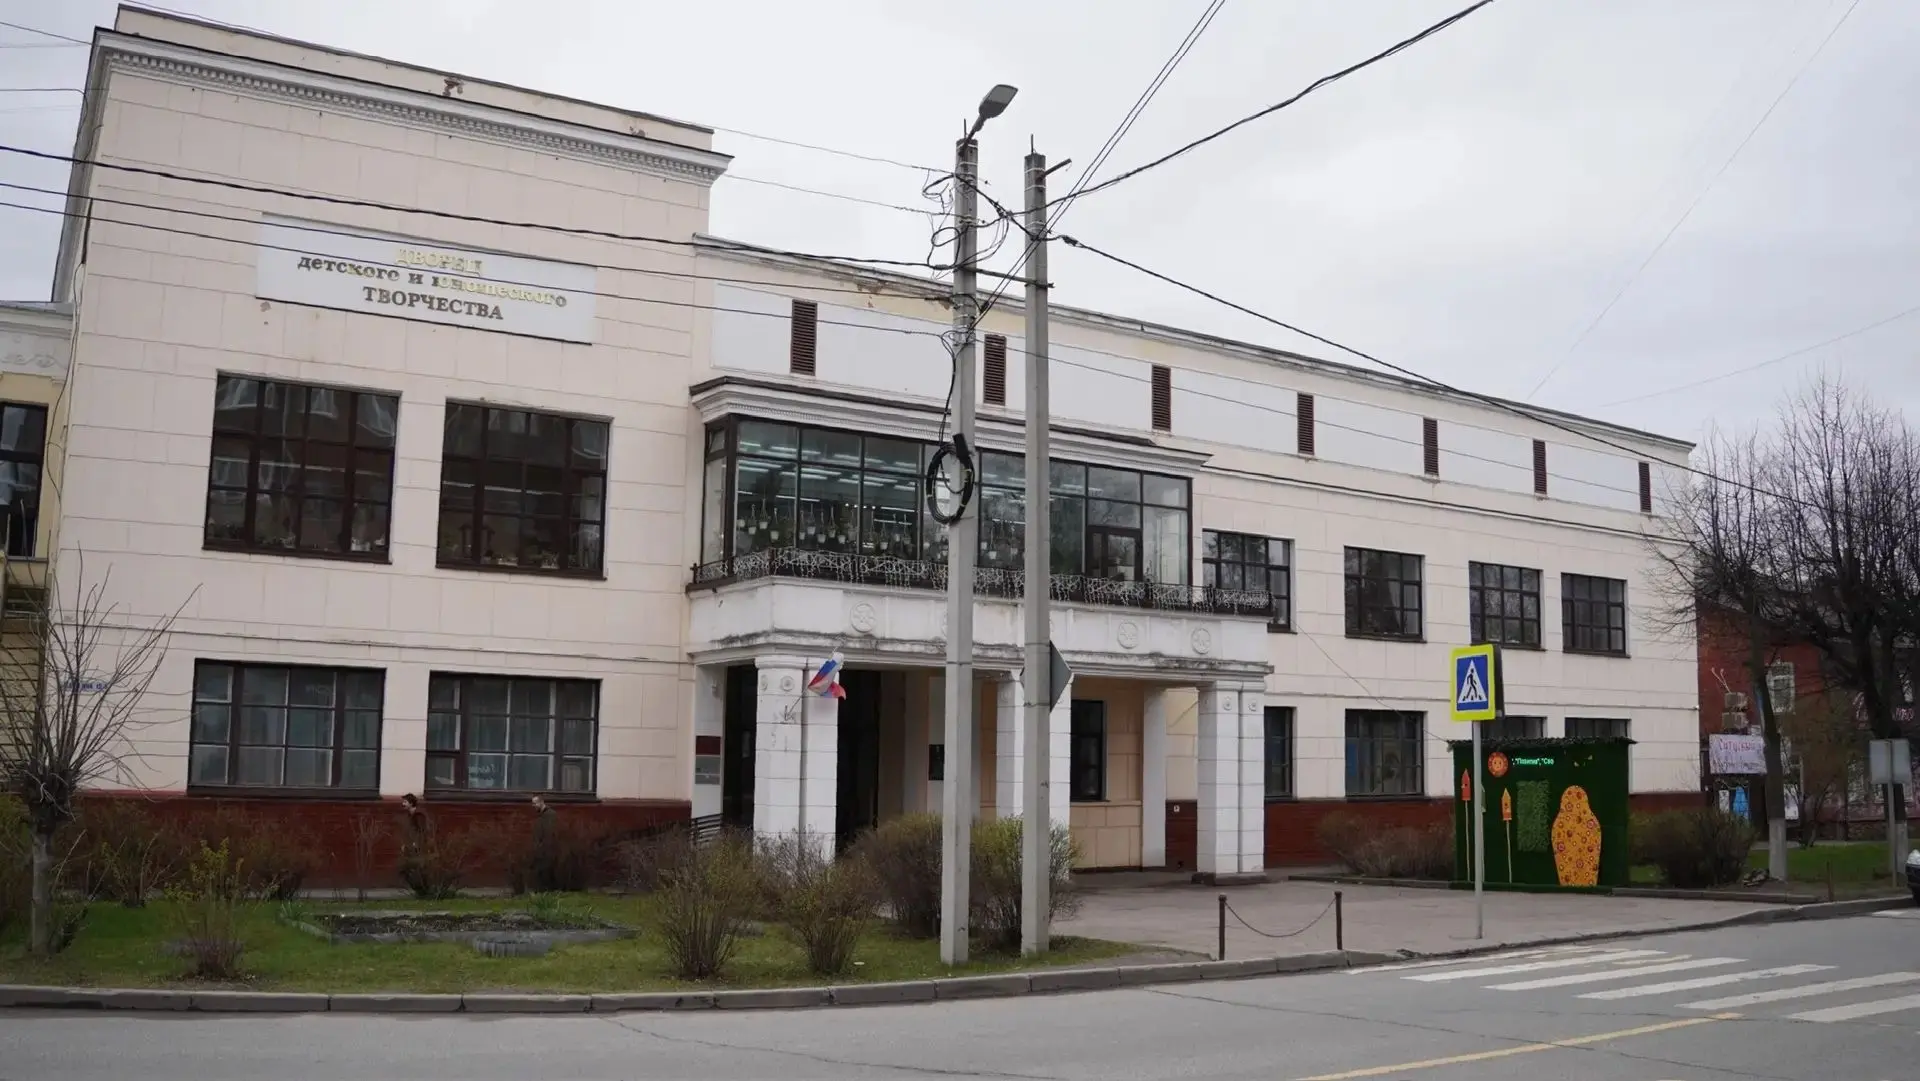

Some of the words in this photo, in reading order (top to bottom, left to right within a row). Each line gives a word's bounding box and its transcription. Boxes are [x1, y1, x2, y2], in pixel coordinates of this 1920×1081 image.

[395, 248, 484, 278] ДВОРЕЦ
[297, 256, 400, 282] детского
[431, 275, 568, 308] юношеского
[362, 286, 504, 321] ТВОРЧЕСТВА
